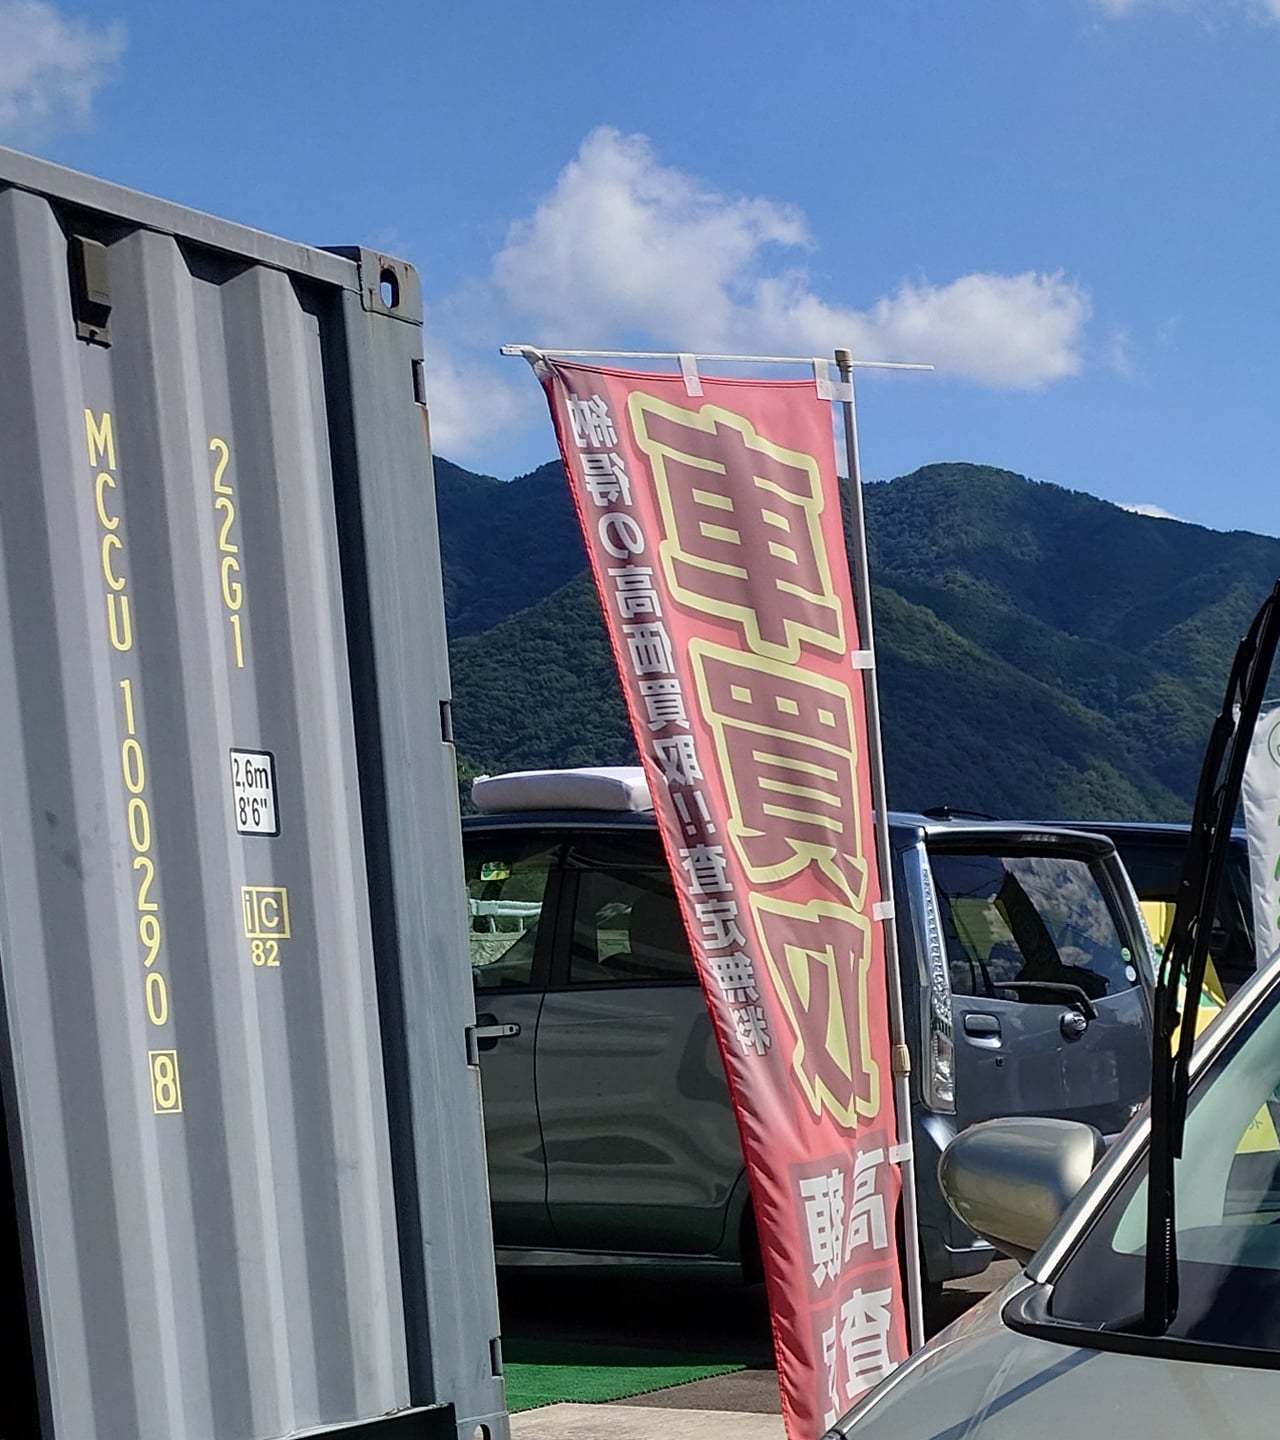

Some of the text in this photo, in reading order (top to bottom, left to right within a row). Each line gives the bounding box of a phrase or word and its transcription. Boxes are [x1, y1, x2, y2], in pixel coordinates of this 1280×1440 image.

[209, 437, 245, 669] 22G1
[83, 408, 177, 1107] MCCU 100290 8
[251, 940, 281, 967] 82
